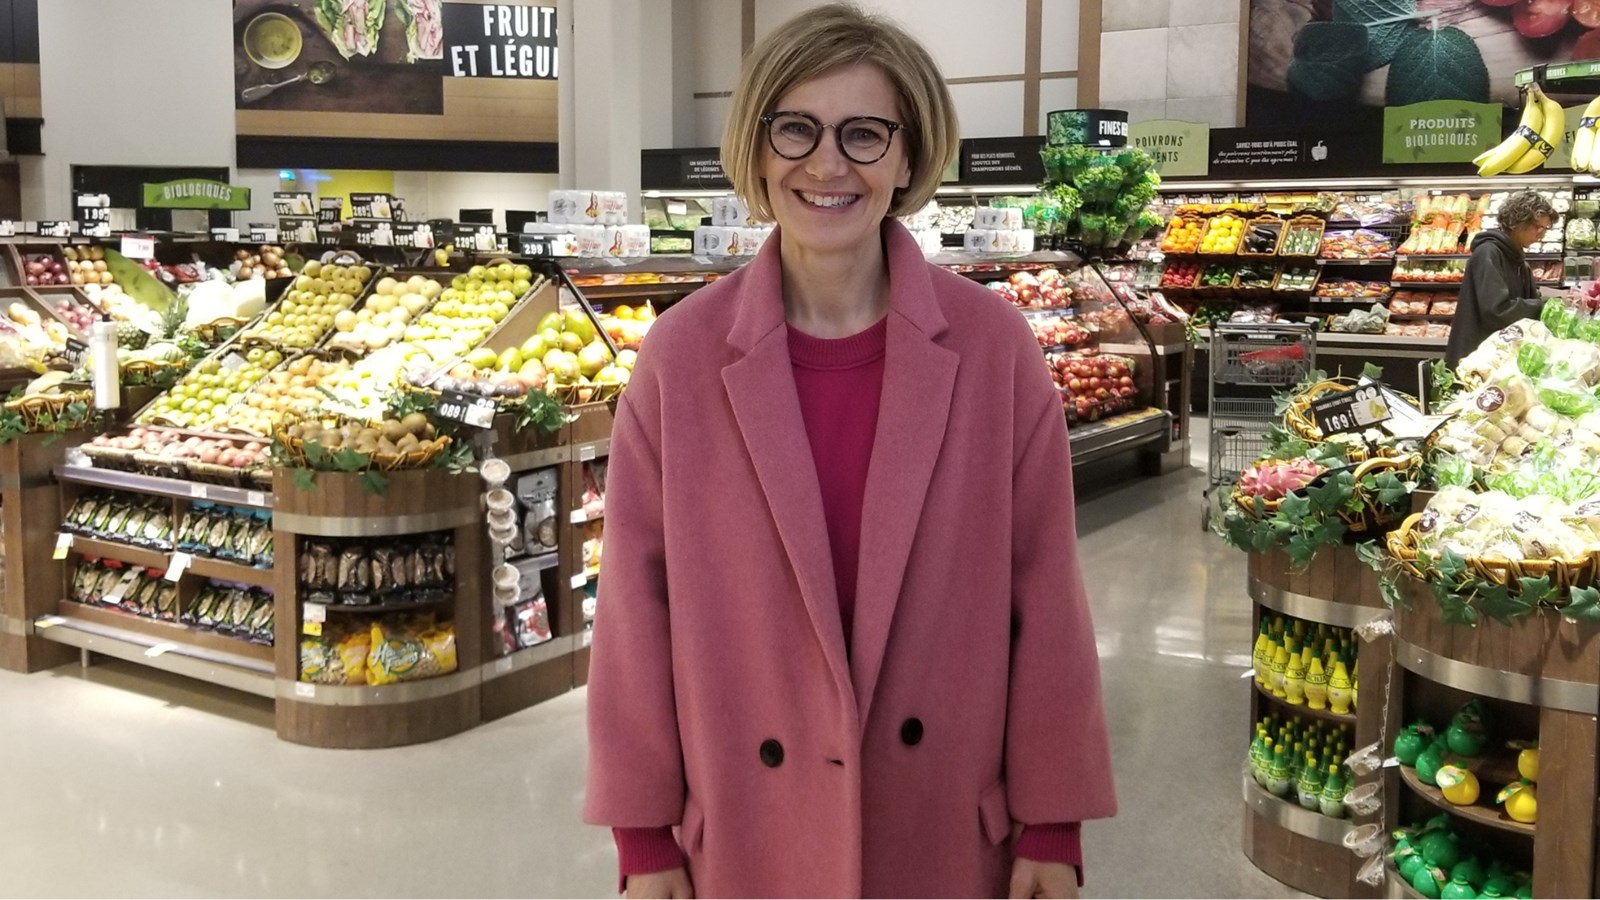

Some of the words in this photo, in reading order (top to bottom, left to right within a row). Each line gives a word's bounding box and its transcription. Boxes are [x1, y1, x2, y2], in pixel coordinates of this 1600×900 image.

[483, 5, 558, 38] FRUIT
[451, 45, 479, 77] ET
[1099, 120, 1121, 136] FINES
[1410, 117, 1476, 130] PRODUITS
[1135, 135, 1185, 149] POIVRONS
[1405, 133, 1479, 148] BIOLOGIQUES
[163, 183, 232, 201] BIOLOGIQUES
[1325, 413, 1350, 433] 169
